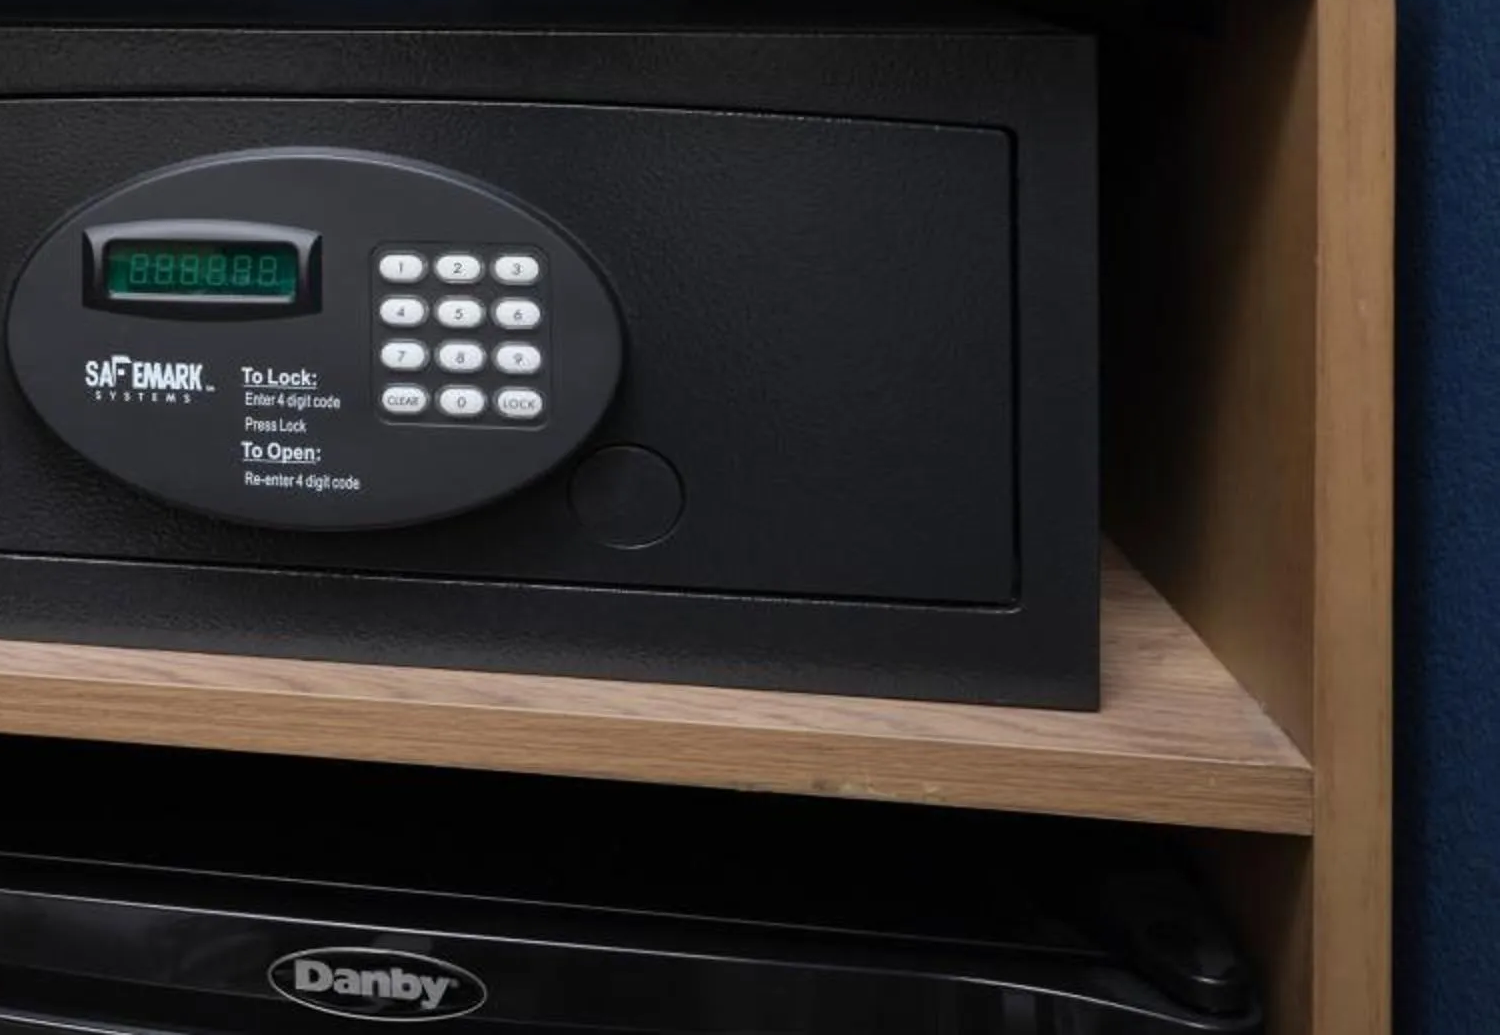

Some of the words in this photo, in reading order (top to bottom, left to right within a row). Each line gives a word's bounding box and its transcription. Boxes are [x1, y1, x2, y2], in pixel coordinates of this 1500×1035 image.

[453, 262, 462, 274] 2
[511, 263, 521, 275] 3
[396, 307, 405, 317] 4
[454, 309, 463, 320] 5
[513, 309, 523, 320] 6
[397, 351, 406, 363] 7
[456, 352, 465, 364] 8
[514, 353, 523, 365] 9
[85, 355, 204, 392] SAFEMARK
[241, 367, 262, 385] To
[267, 368, 318, 387] Lock:
[95, 391, 192, 403] SYSTEMS
[245, 393, 276, 407] Enter
[277, 393, 286, 407] 4
[287, 393, 312, 411] digit
[313, 394, 341, 409] code
[387, 396, 419, 406] CLEAR
[503, 398, 536, 410] LOCK
[245, 417, 277, 432] Press
[279, 417, 307, 433] Lock
[241, 441, 262, 458] To
[267, 442, 322, 462] Open:
[245, 471, 295, 487] Re-enter
[295, 473, 304, 487] 4
[306, 473, 332, 491] digit
[333, 475, 361, 490] code
[295, 959, 450, 1010] Danby
